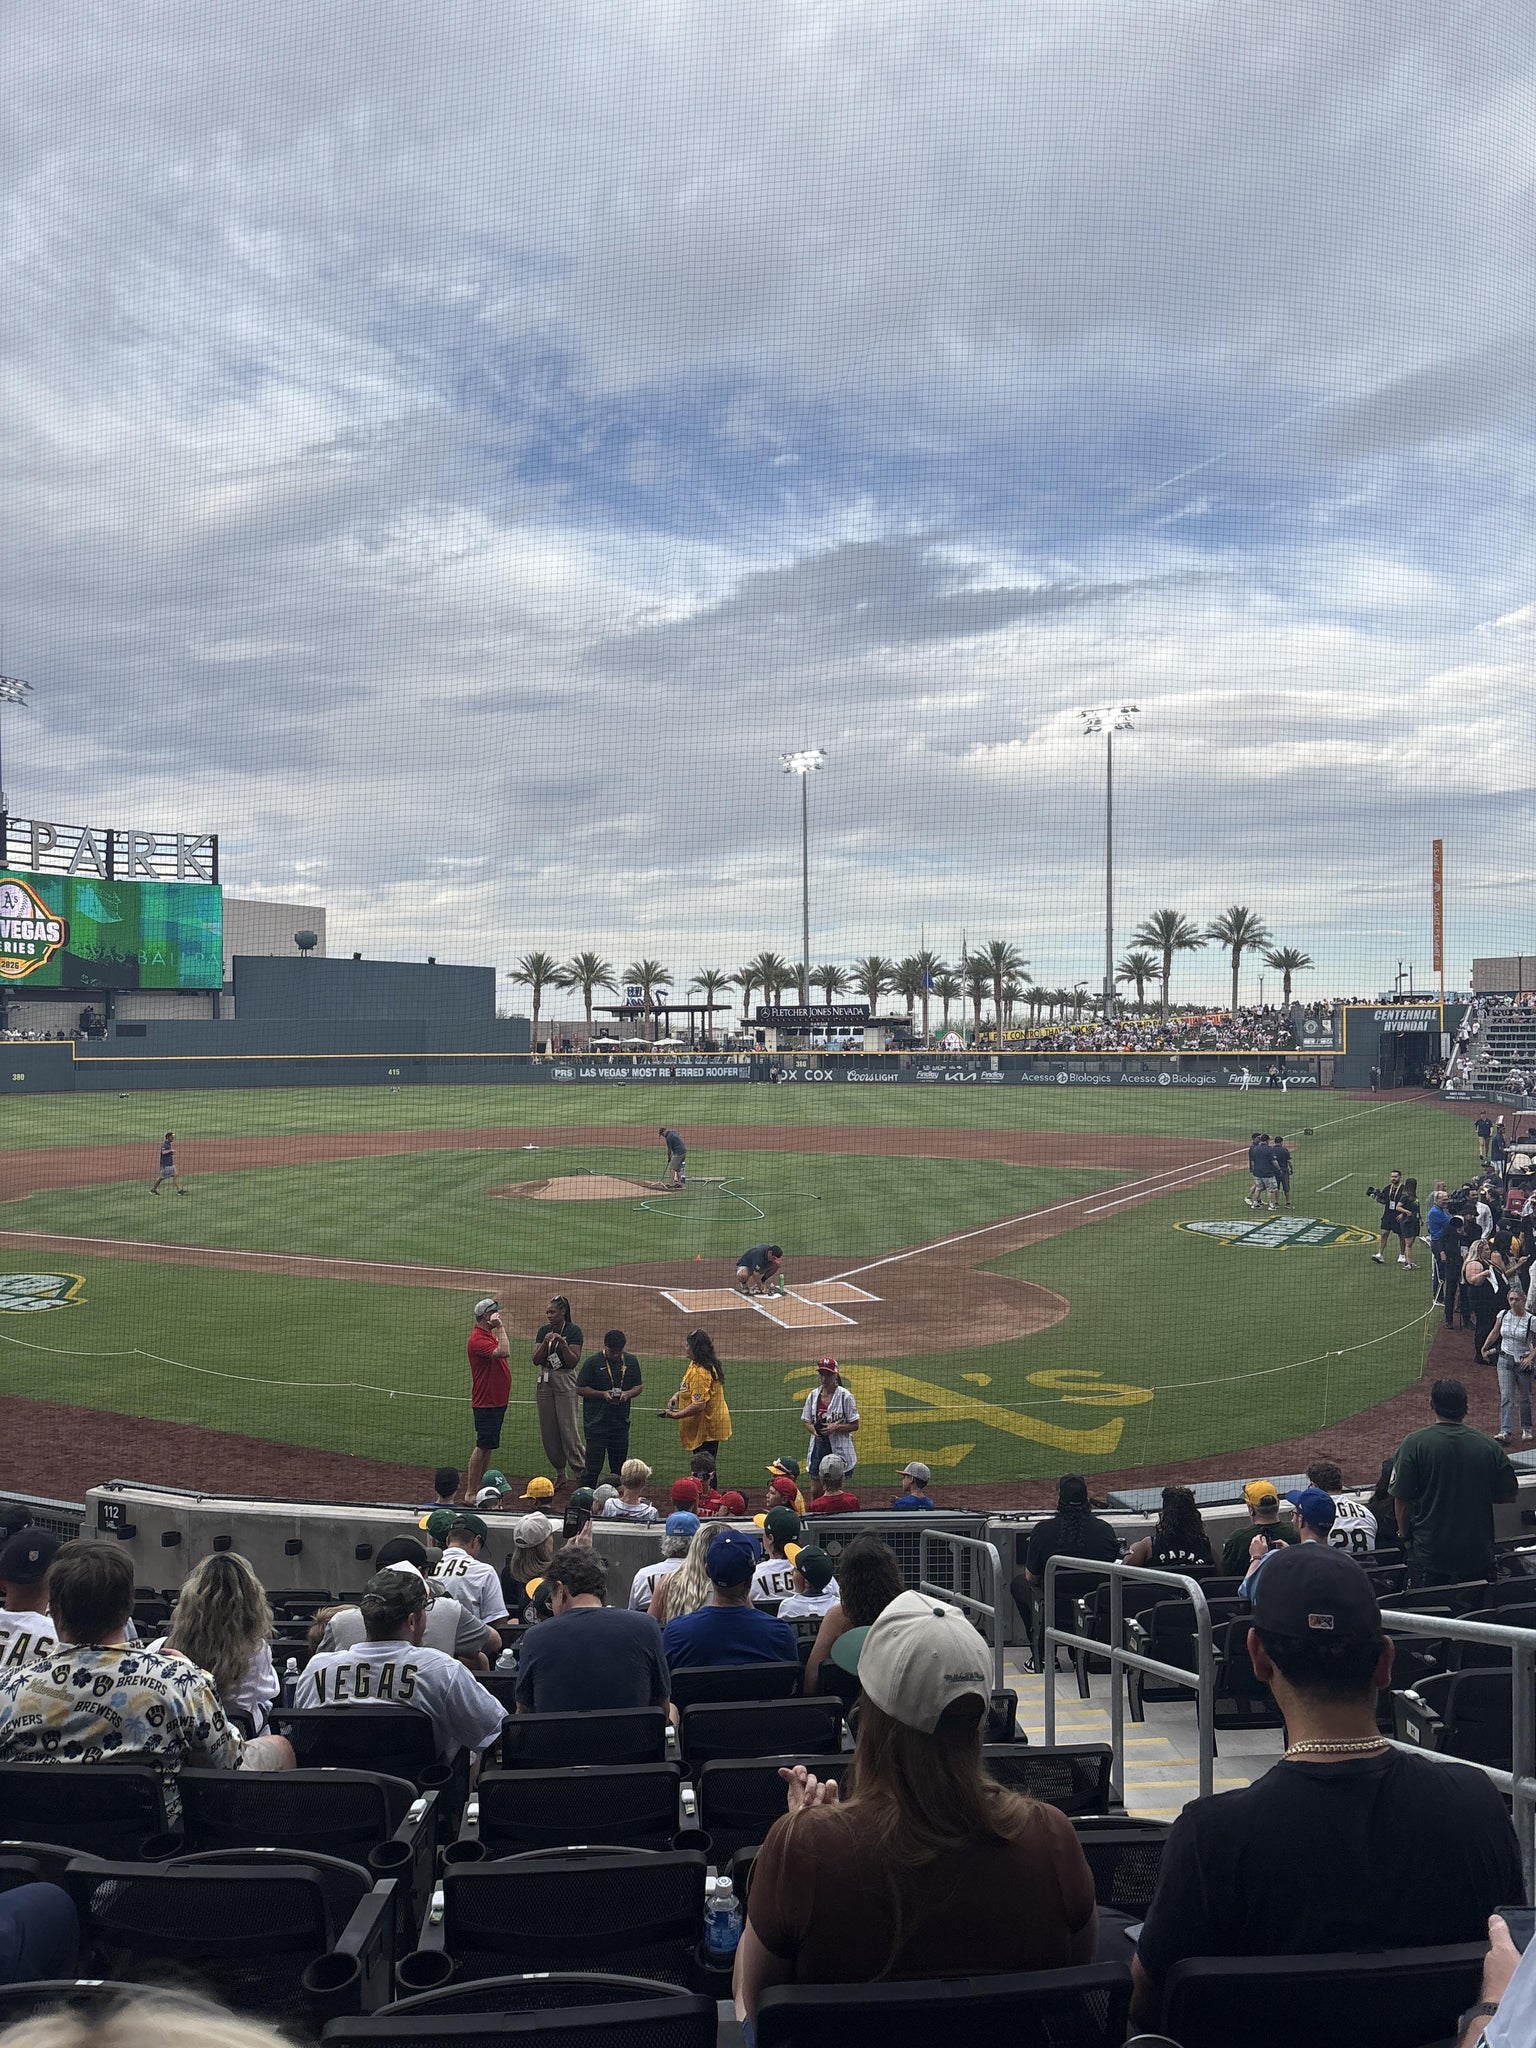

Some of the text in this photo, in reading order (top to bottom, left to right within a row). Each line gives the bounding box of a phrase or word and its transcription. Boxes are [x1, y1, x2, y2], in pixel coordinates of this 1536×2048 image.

[32, 820, 214, 880] PARK
[0, 919, 60, 942] VEGAS
[0, 942, 35, 955] RIES
[771, 1006, 864, 1018] FLETCHER JONES NEVADA
[1374, 1009, 1437, 1020] CENTENNIAL
[1384, 1021, 1428, 1032] HYUNDAI
[12, 1073, 25, 1081] 380
[388, 1068, 400, 1076] 415
[580, 1068, 597, 1077] LAS
[598, 1068, 630, 1078] VEGAS'
[631, 1068, 657, 1077] MOST
[659, 1067, 704, 1077] REERRED
[706, 1067, 738, 1077] ROOFER
[804, 1069, 833, 1081] COX
[847, 1070, 899, 1082] Coors LIGHT
[1021, 1072, 1111, 1084] Acesso Biologics
[1120, 1073, 1217, 1085] Acesso Biologics
[1265, 1076, 1317, 1084] TYOTA
[783, 1365, 1154, 1474] A's
[103, 1504, 119, 1519] 112
[1330, 1528, 1368, 1553] 28
[116, 1675, 168, 1697] BREWERS
[314, 1661, 418, 1704] VEGAS
[73, 1701, 122, 1729] BREWERS
